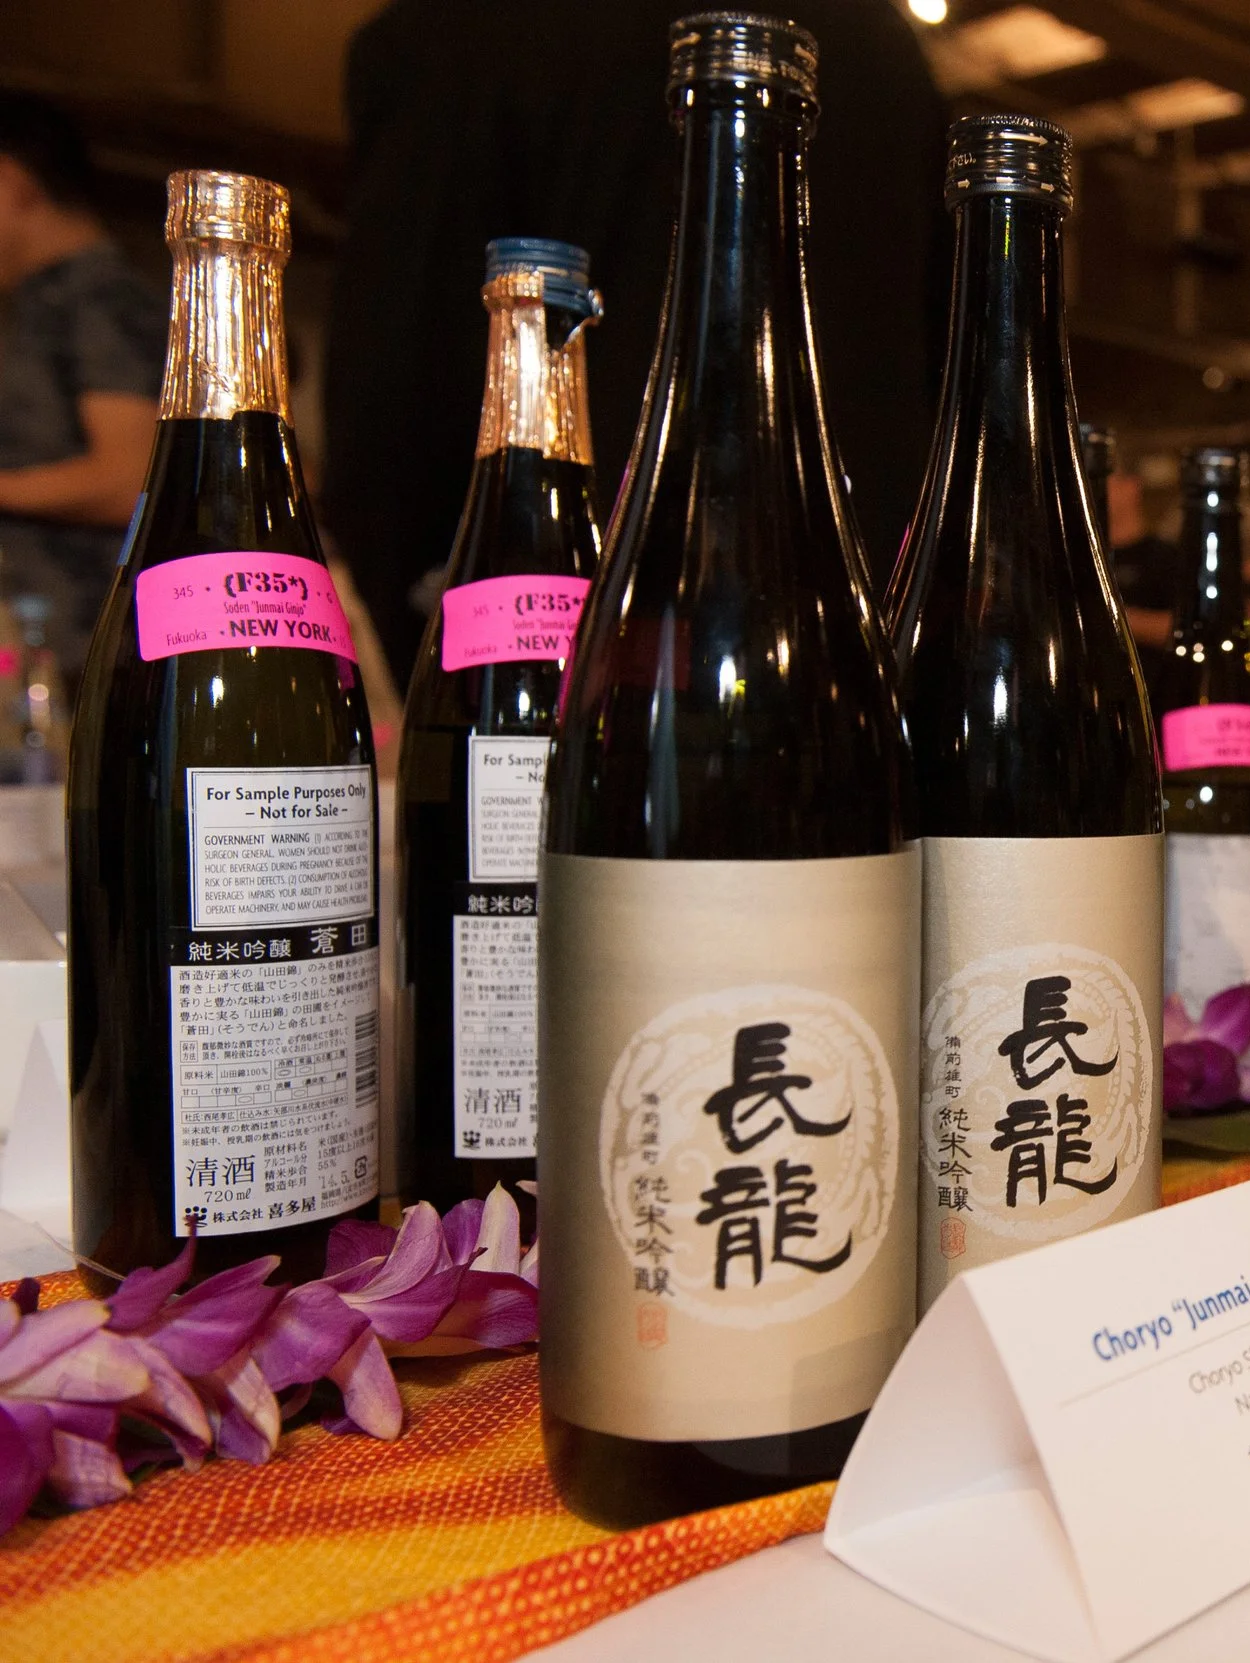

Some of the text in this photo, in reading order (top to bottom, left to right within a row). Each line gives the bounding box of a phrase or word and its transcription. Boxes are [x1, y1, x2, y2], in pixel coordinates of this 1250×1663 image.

[173, 587, 194, 600] 345
[223, 601, 250, 614] Soden
[166, 631, 207, 646] Fukuoka
[229, 619, 278, 637] NEW
[283, 619, 331, 643] YORK
[517, 635, 559, 650] NEW
[483, 753, 547, 768] For Sampl
[528, 771, 546, 783] No
[207, 782, 367, 804] For Sample Purposes Only
[260, 803, 338, 819] Not for Sale
[204, 834, 265, 846] GOVERNMENT
[271, 832, 310, 844] WARNING
[204, 849, 239, 860] SURGEON
[204, 863, 227, 873] HOLIC
[229, 862, 268, 873] BEVERAGES
[205, 877, 220, 887] RISK
[222, 877, 232, 887] OF
[235, 877, 255, 886] BIRTH
[205, 890, 244, 901] BEVERAGES
[467, 893, 534, 914] 純米吟
[205, 904, 236, 915] OPERATE
[188, 923, 367, 962] 純米吟醸 蒼田
[944, 1035, 962, 1099] 備前雄町
[990, 974, 1120, 1208] 長龍
[464, 1087, 522, 1114] 清酒
[263, 1141, 308, 1157] 原材料名
[695, 1021, 852, 1291] 長龍
[937, 1106, 974, 1213] 純米吟醸
[185, 1154, 256, 1187] 清酒
[212, 1207, 264, 1224] 株式会社
[633, 1174, 675, 1298] 純米吟醸
[1092, 1314, 1174, 1361] Choryo
[1188, 1357, 1244, 1396] Choryo
